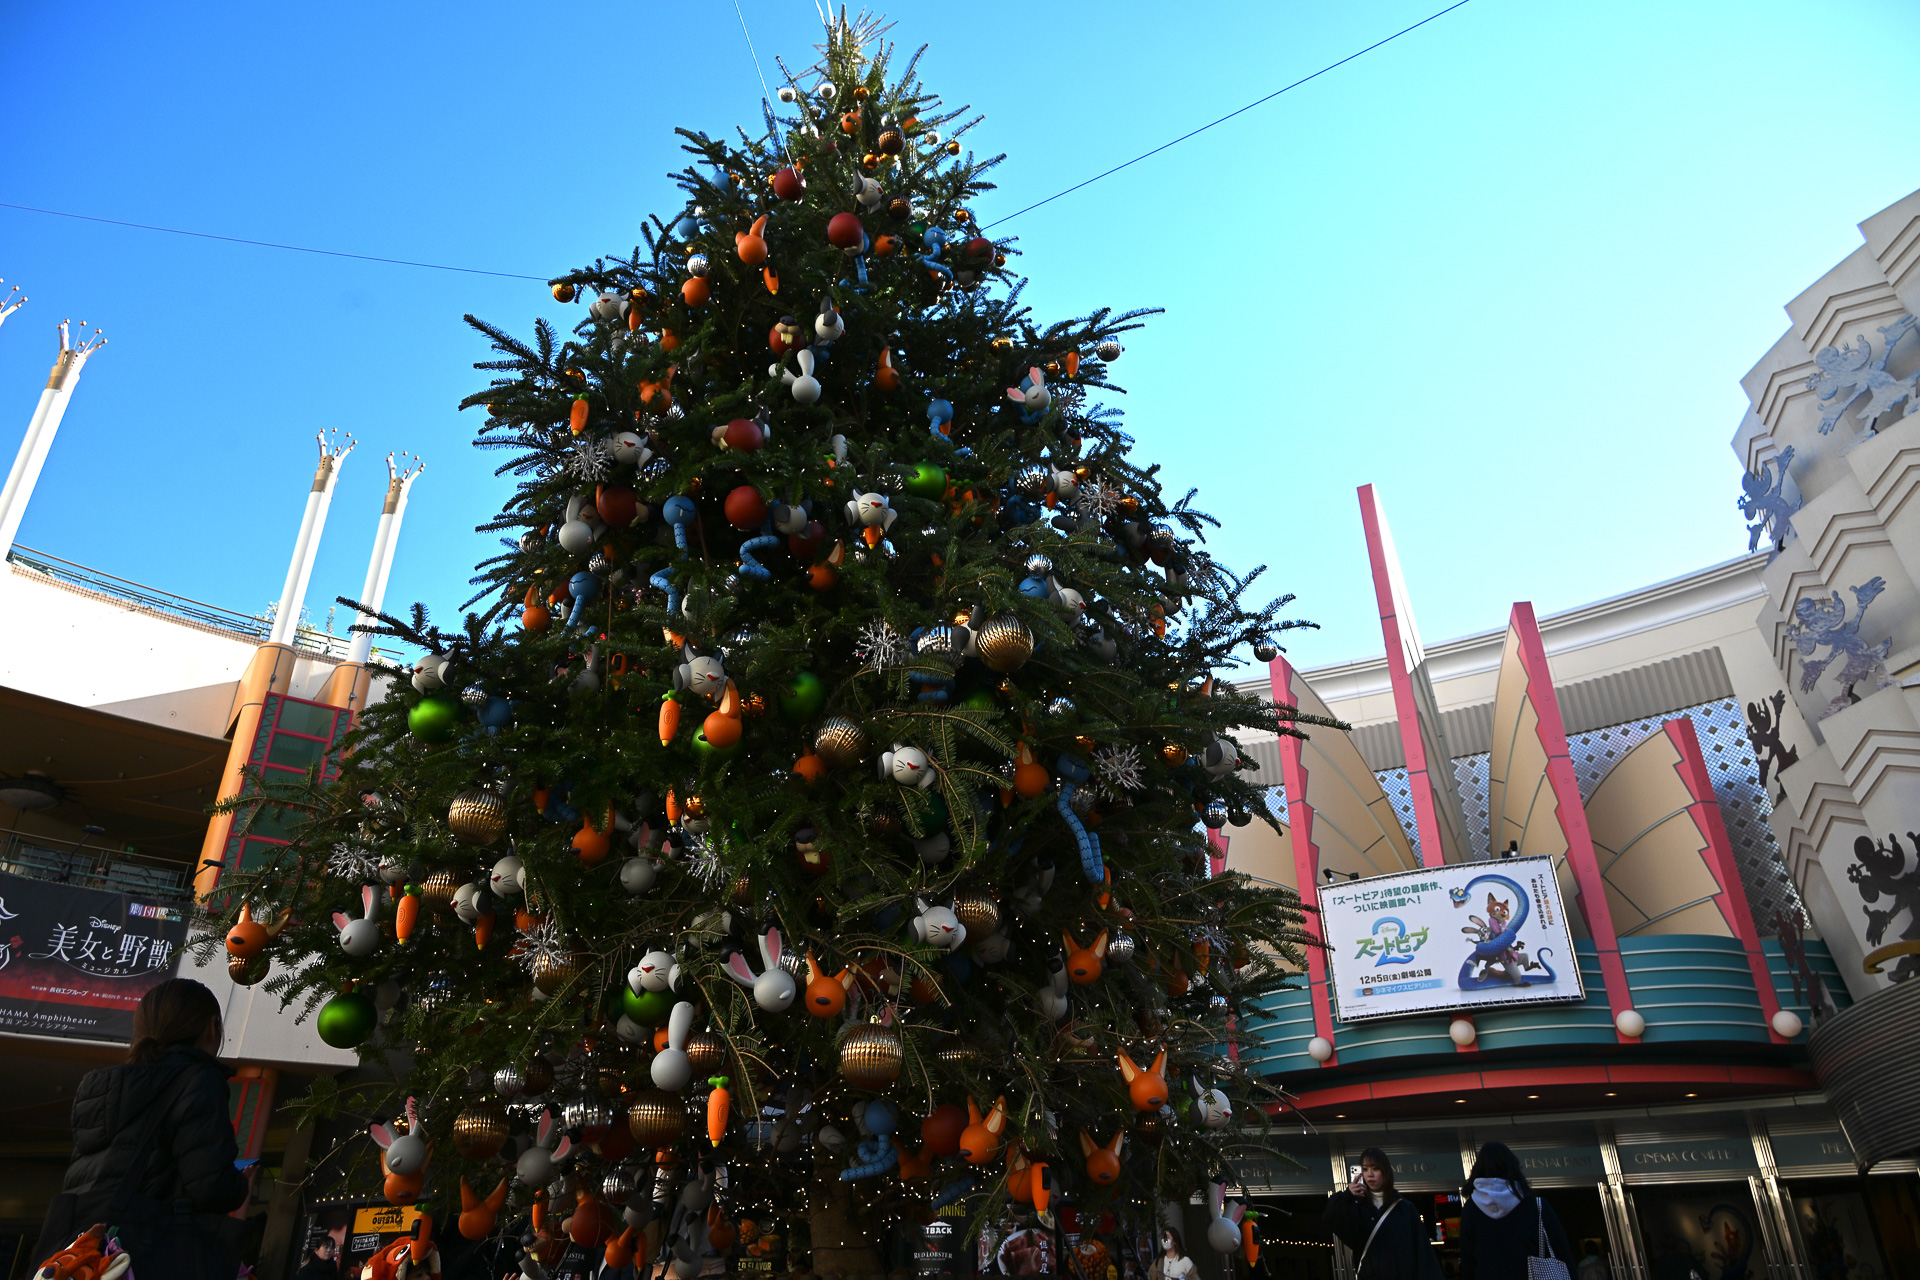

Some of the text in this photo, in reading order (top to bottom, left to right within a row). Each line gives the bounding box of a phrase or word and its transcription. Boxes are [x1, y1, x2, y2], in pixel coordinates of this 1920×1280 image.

[1332, 881, 1443, 906] 「ズートピア」待望の最新作、
[130, 904, 181, 922] 劇団四
[47, 922, 173, 969] 美女と野獣
[1354, 926, 1430, 960] ズートピア
[81, 963, 129, 975] ミュージカル
[33, 1012, 98, 1025] Amphitheater
[1634, 1152, 1679, 1164] CINEMA
[925, 1226, 953, 1235] TBACK
